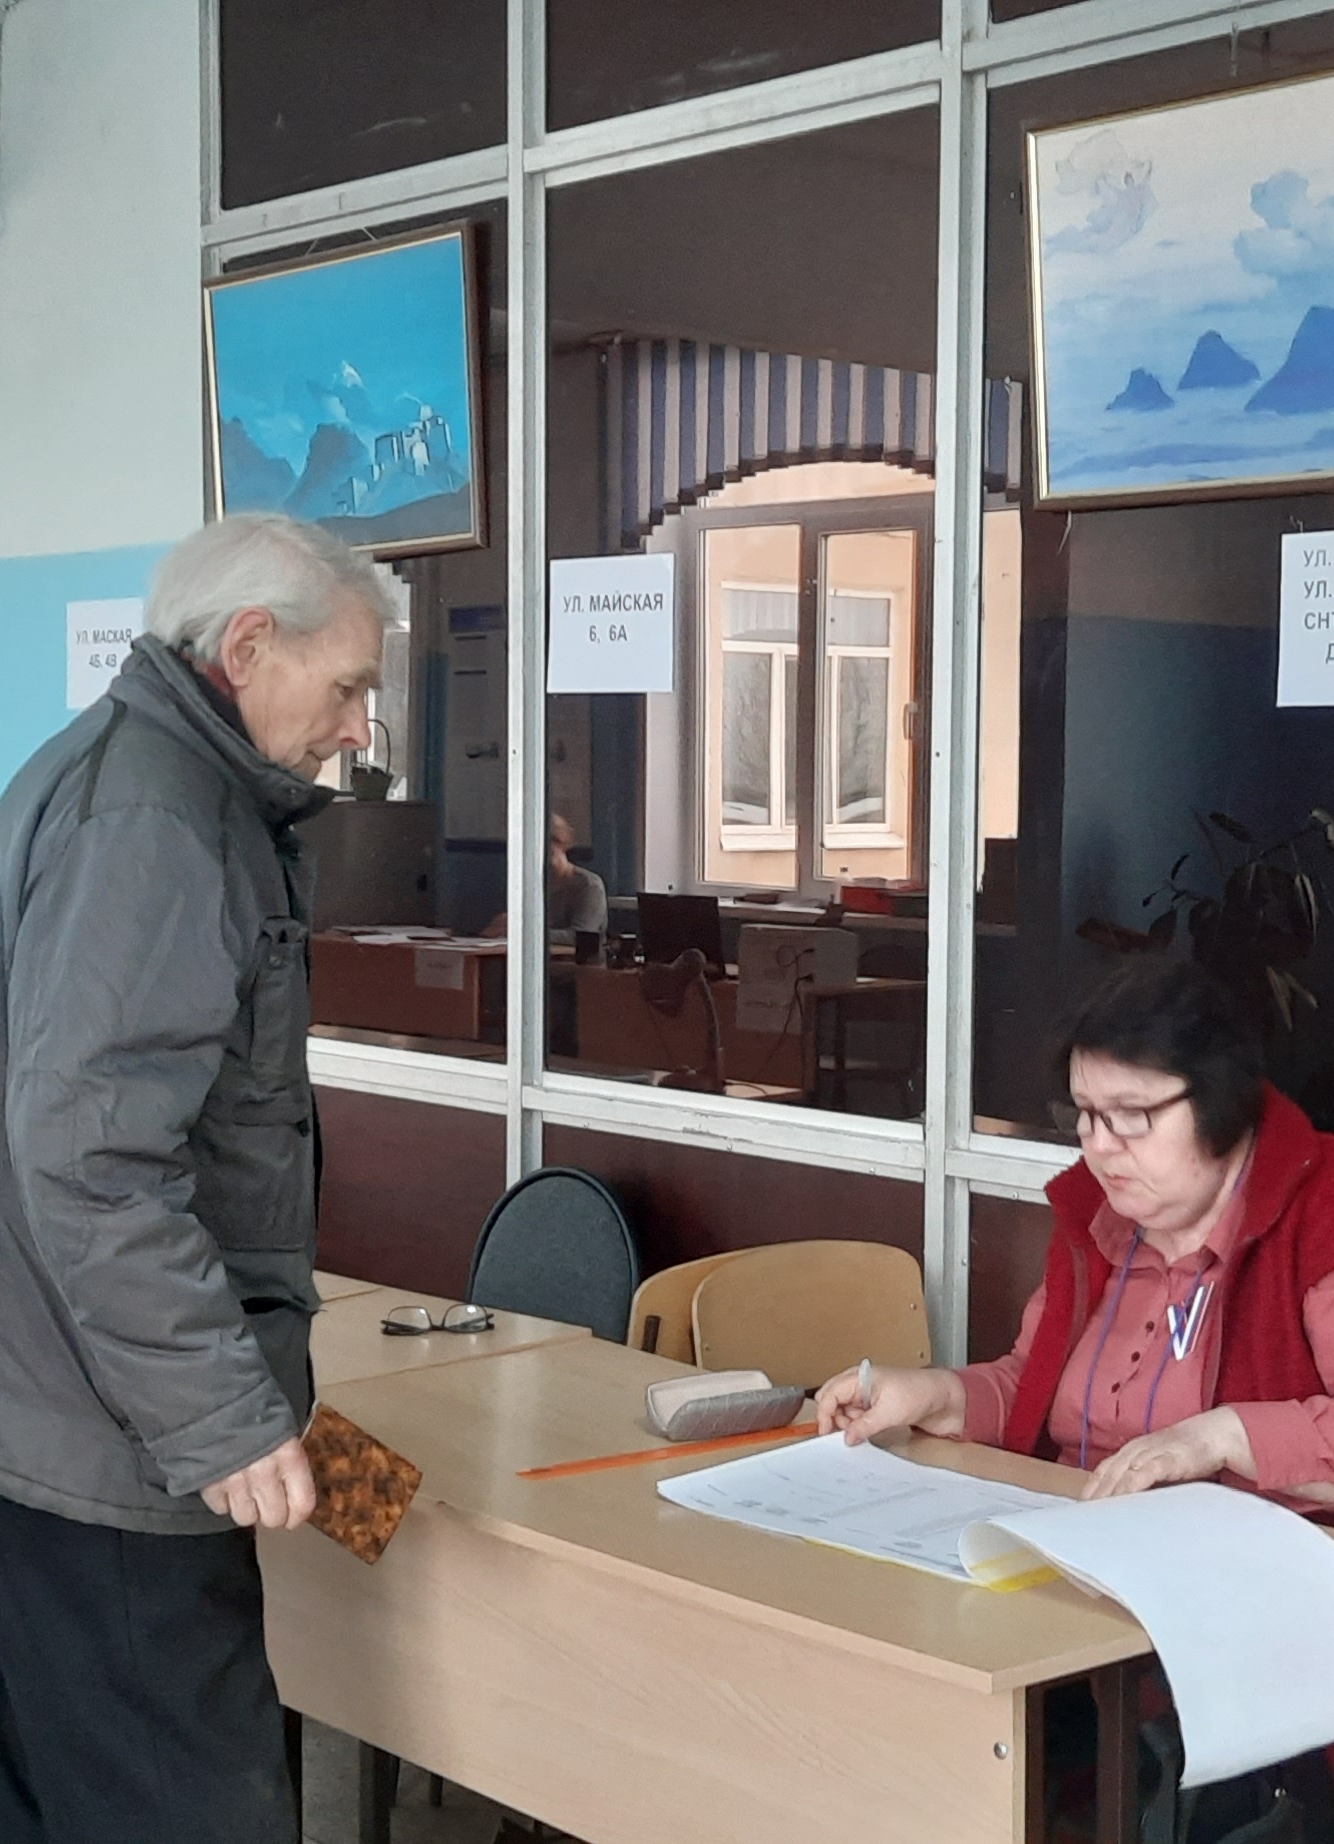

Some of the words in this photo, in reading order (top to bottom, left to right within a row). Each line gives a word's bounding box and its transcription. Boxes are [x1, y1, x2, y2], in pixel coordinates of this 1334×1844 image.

[1302, 550, 1332, 567] УЛ.
[1303, 580, 1333, 599] УЛ.
[563, 595, 585, 613] УЛ.
[589, 590, 664, 612] МАЙСКАЯ
[92, 628, 133, 644] МАСКАЯ
[589, 625, 601, 644] 6,
[609, 624, 628, 641] 6А
